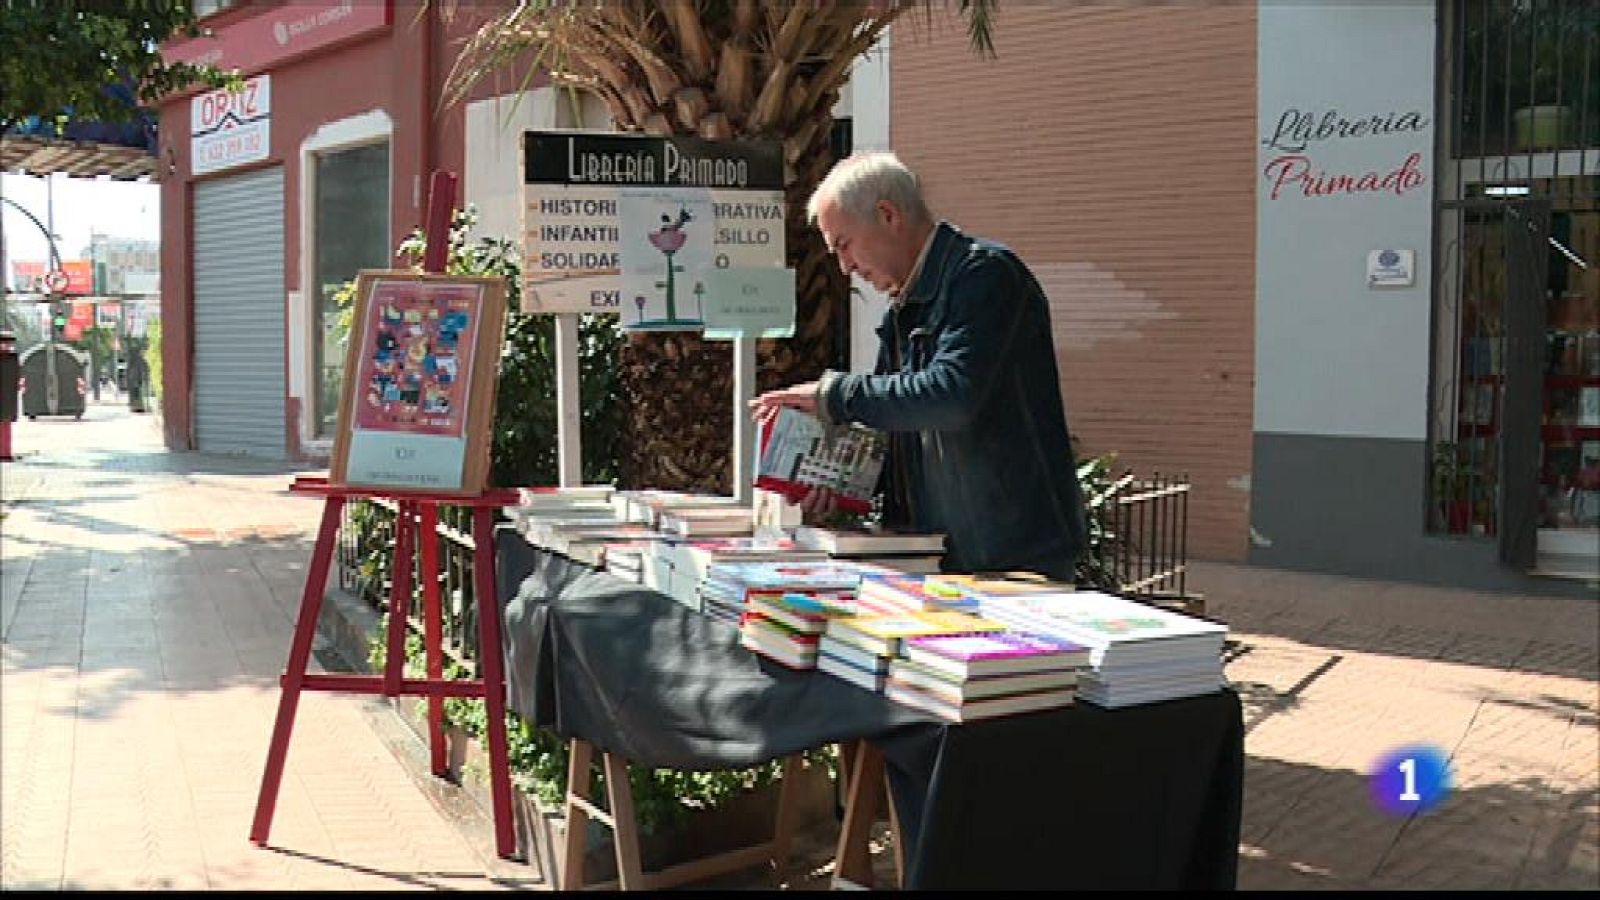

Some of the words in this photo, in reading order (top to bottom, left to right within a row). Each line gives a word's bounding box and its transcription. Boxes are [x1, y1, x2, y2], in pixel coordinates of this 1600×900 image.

[663, 140, 748, 186] PRIMADO
[1263, 151, 1426, 200] Primado
[540, 199, 617, 216] HISTORI
[713, 227, 770, 245] SILLO
